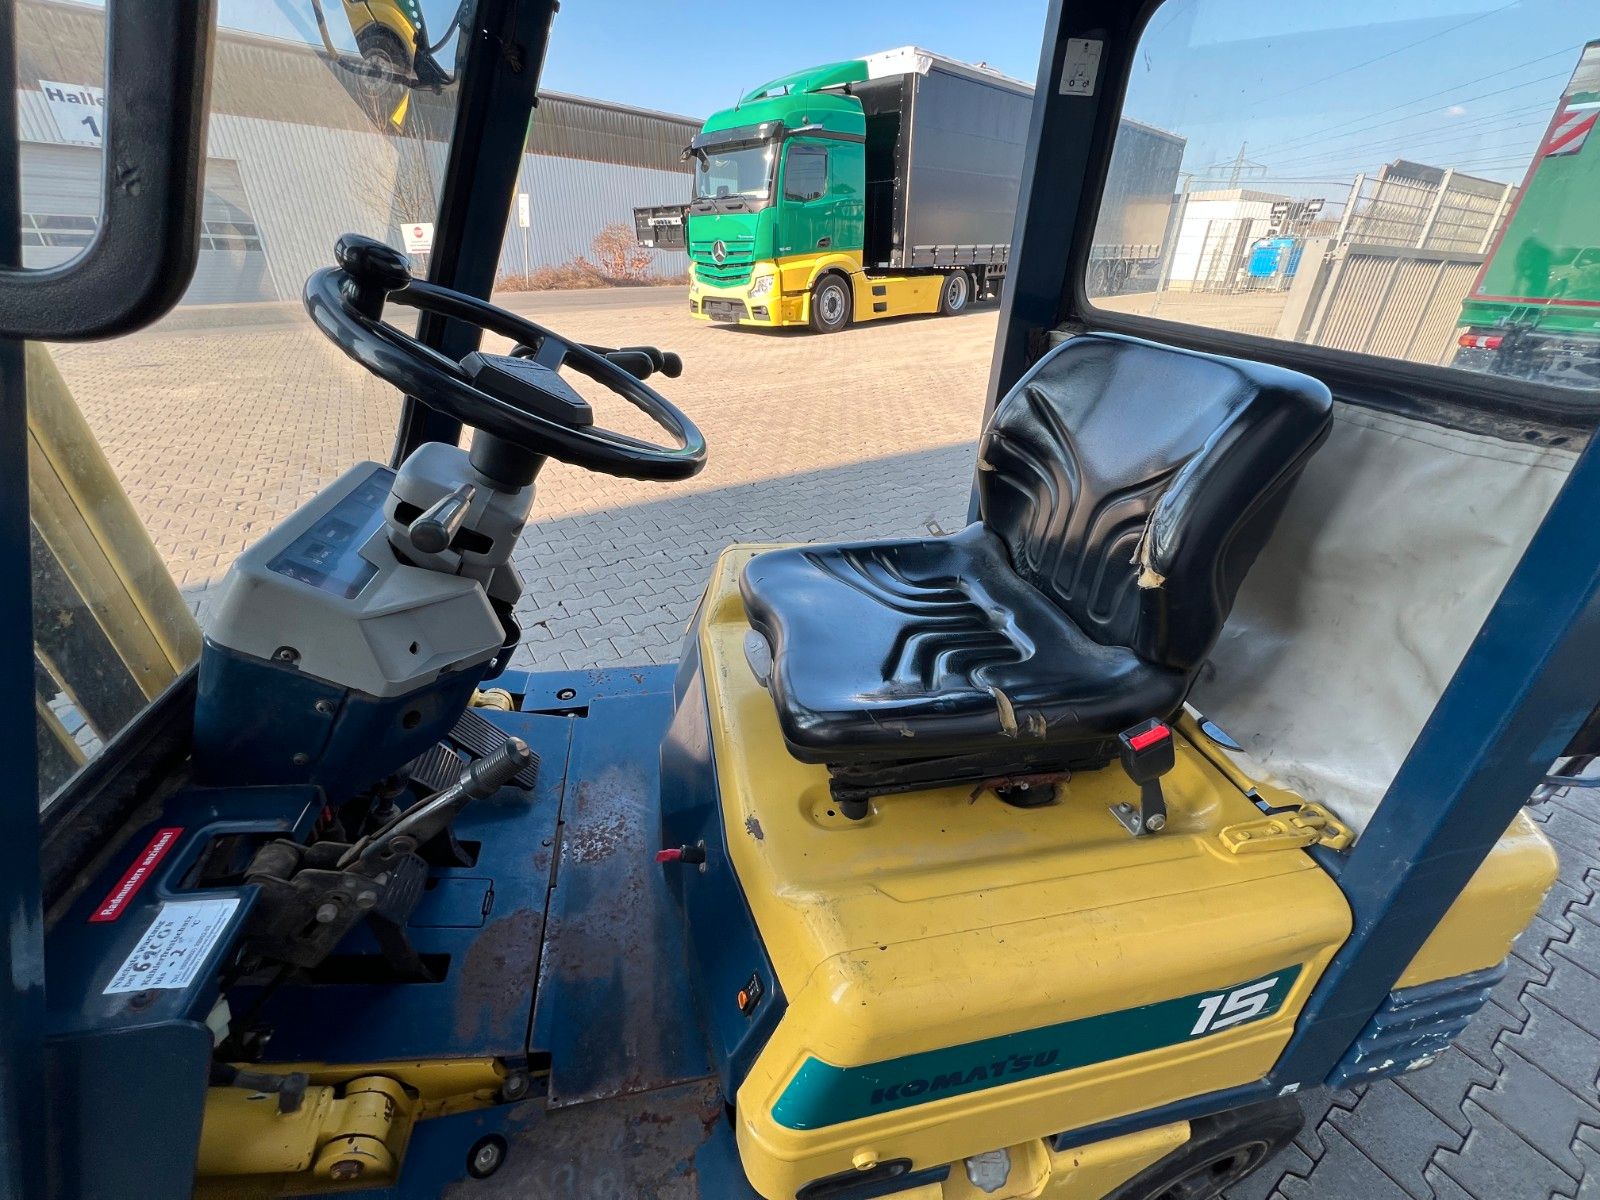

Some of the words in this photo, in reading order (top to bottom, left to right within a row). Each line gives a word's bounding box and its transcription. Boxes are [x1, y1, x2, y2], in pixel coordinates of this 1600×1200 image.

[45, 87, 104, 107] Halle
[81, 115, 102, 138] 1
[100, 867, 146, 915] Radmuttern
[142, 832, 173, 866] anziehen!
[110, 953, 142, 988] Nächste
[135, 920, 166, 953] Wartung
[140, 915, 194, 986] Kühlerfrostschutz
[152, 971, 167, 985] bis
[121, 973, 138, 988] bei
[1190, 976, 1280, 1036] 15
[870, 1050, 1060, 1105] KOMATSU
